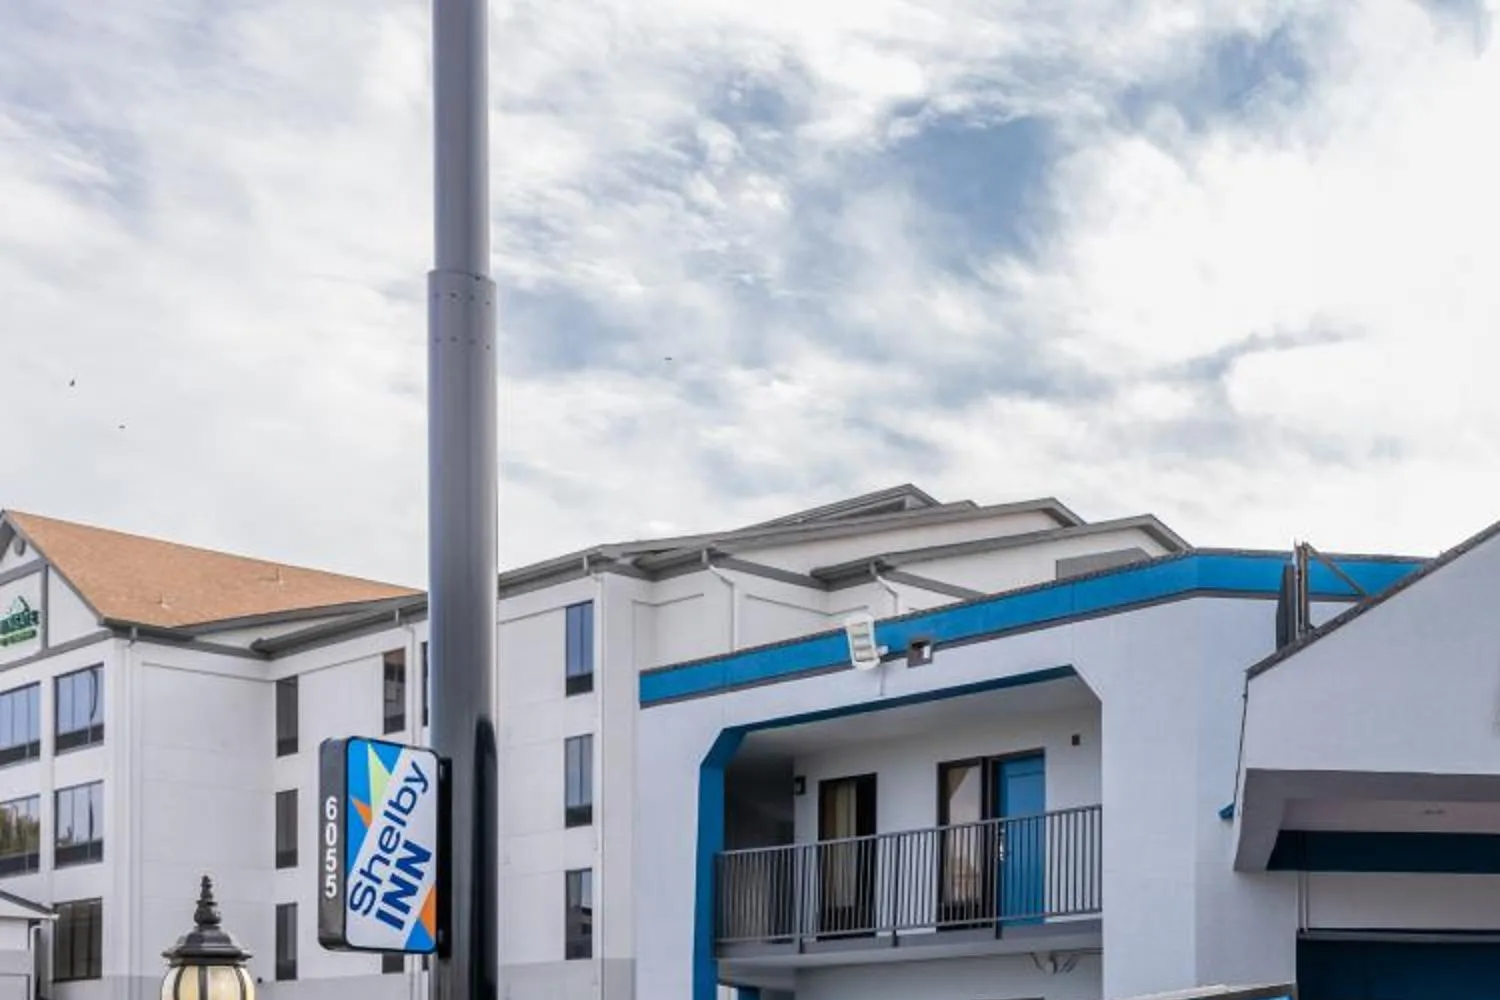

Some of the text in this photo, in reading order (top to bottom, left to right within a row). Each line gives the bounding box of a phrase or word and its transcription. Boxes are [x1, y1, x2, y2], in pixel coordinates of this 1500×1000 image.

[325, 796, 337, 898] 6055
[350, 761, 429, 917] Shelby
[375, 840, 432, 931] INN
